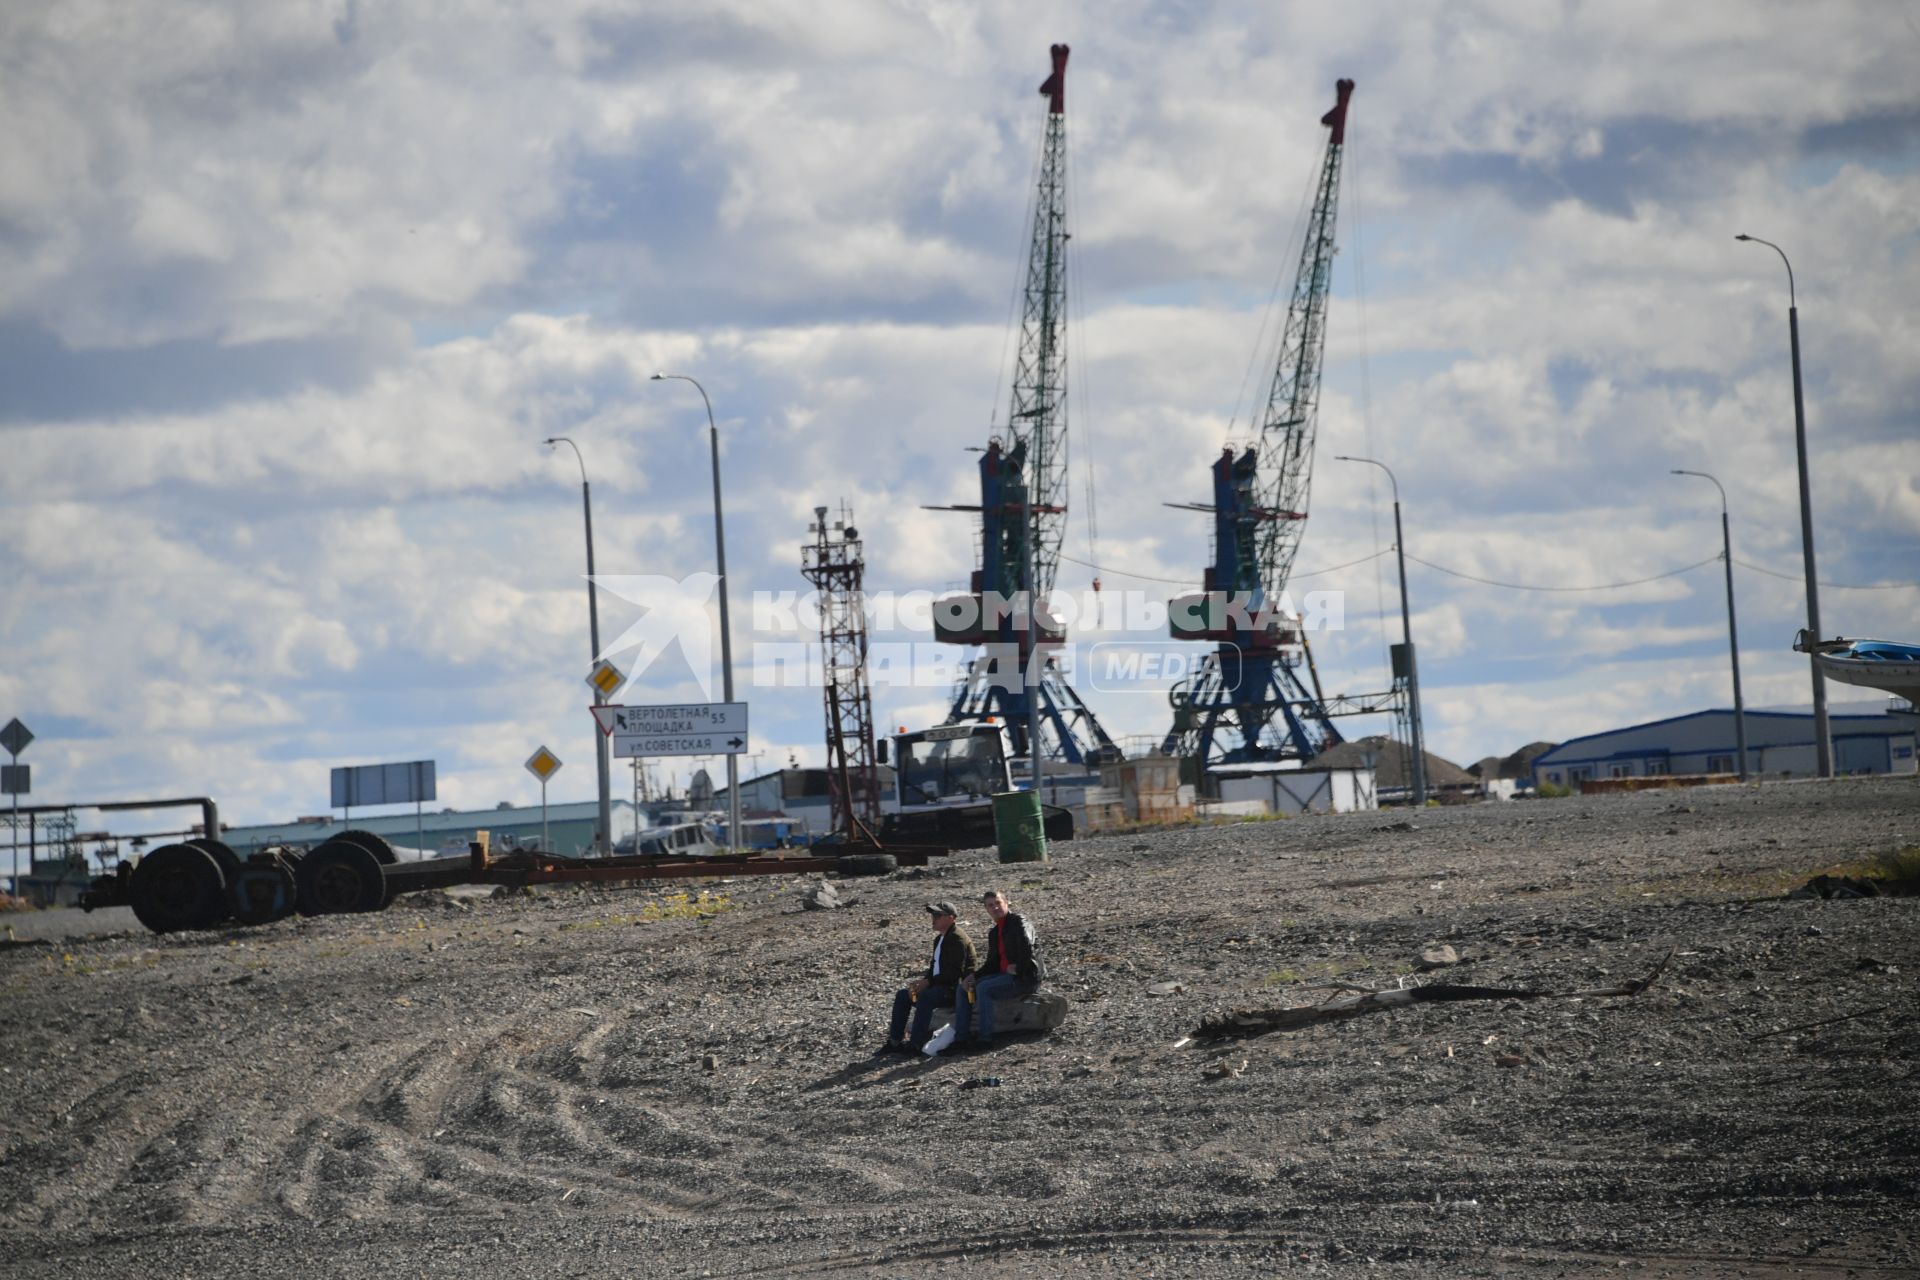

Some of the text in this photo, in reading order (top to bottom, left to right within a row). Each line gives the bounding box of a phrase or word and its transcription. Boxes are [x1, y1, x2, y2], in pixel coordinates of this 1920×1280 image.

[629, 707, 709, 720] ВЕРТОЛЕТНАЯ
[629, 721, 693, 733] ПЛОЩАДКА
[644, 739, 711, 751] СОВЕТСКАЯ
